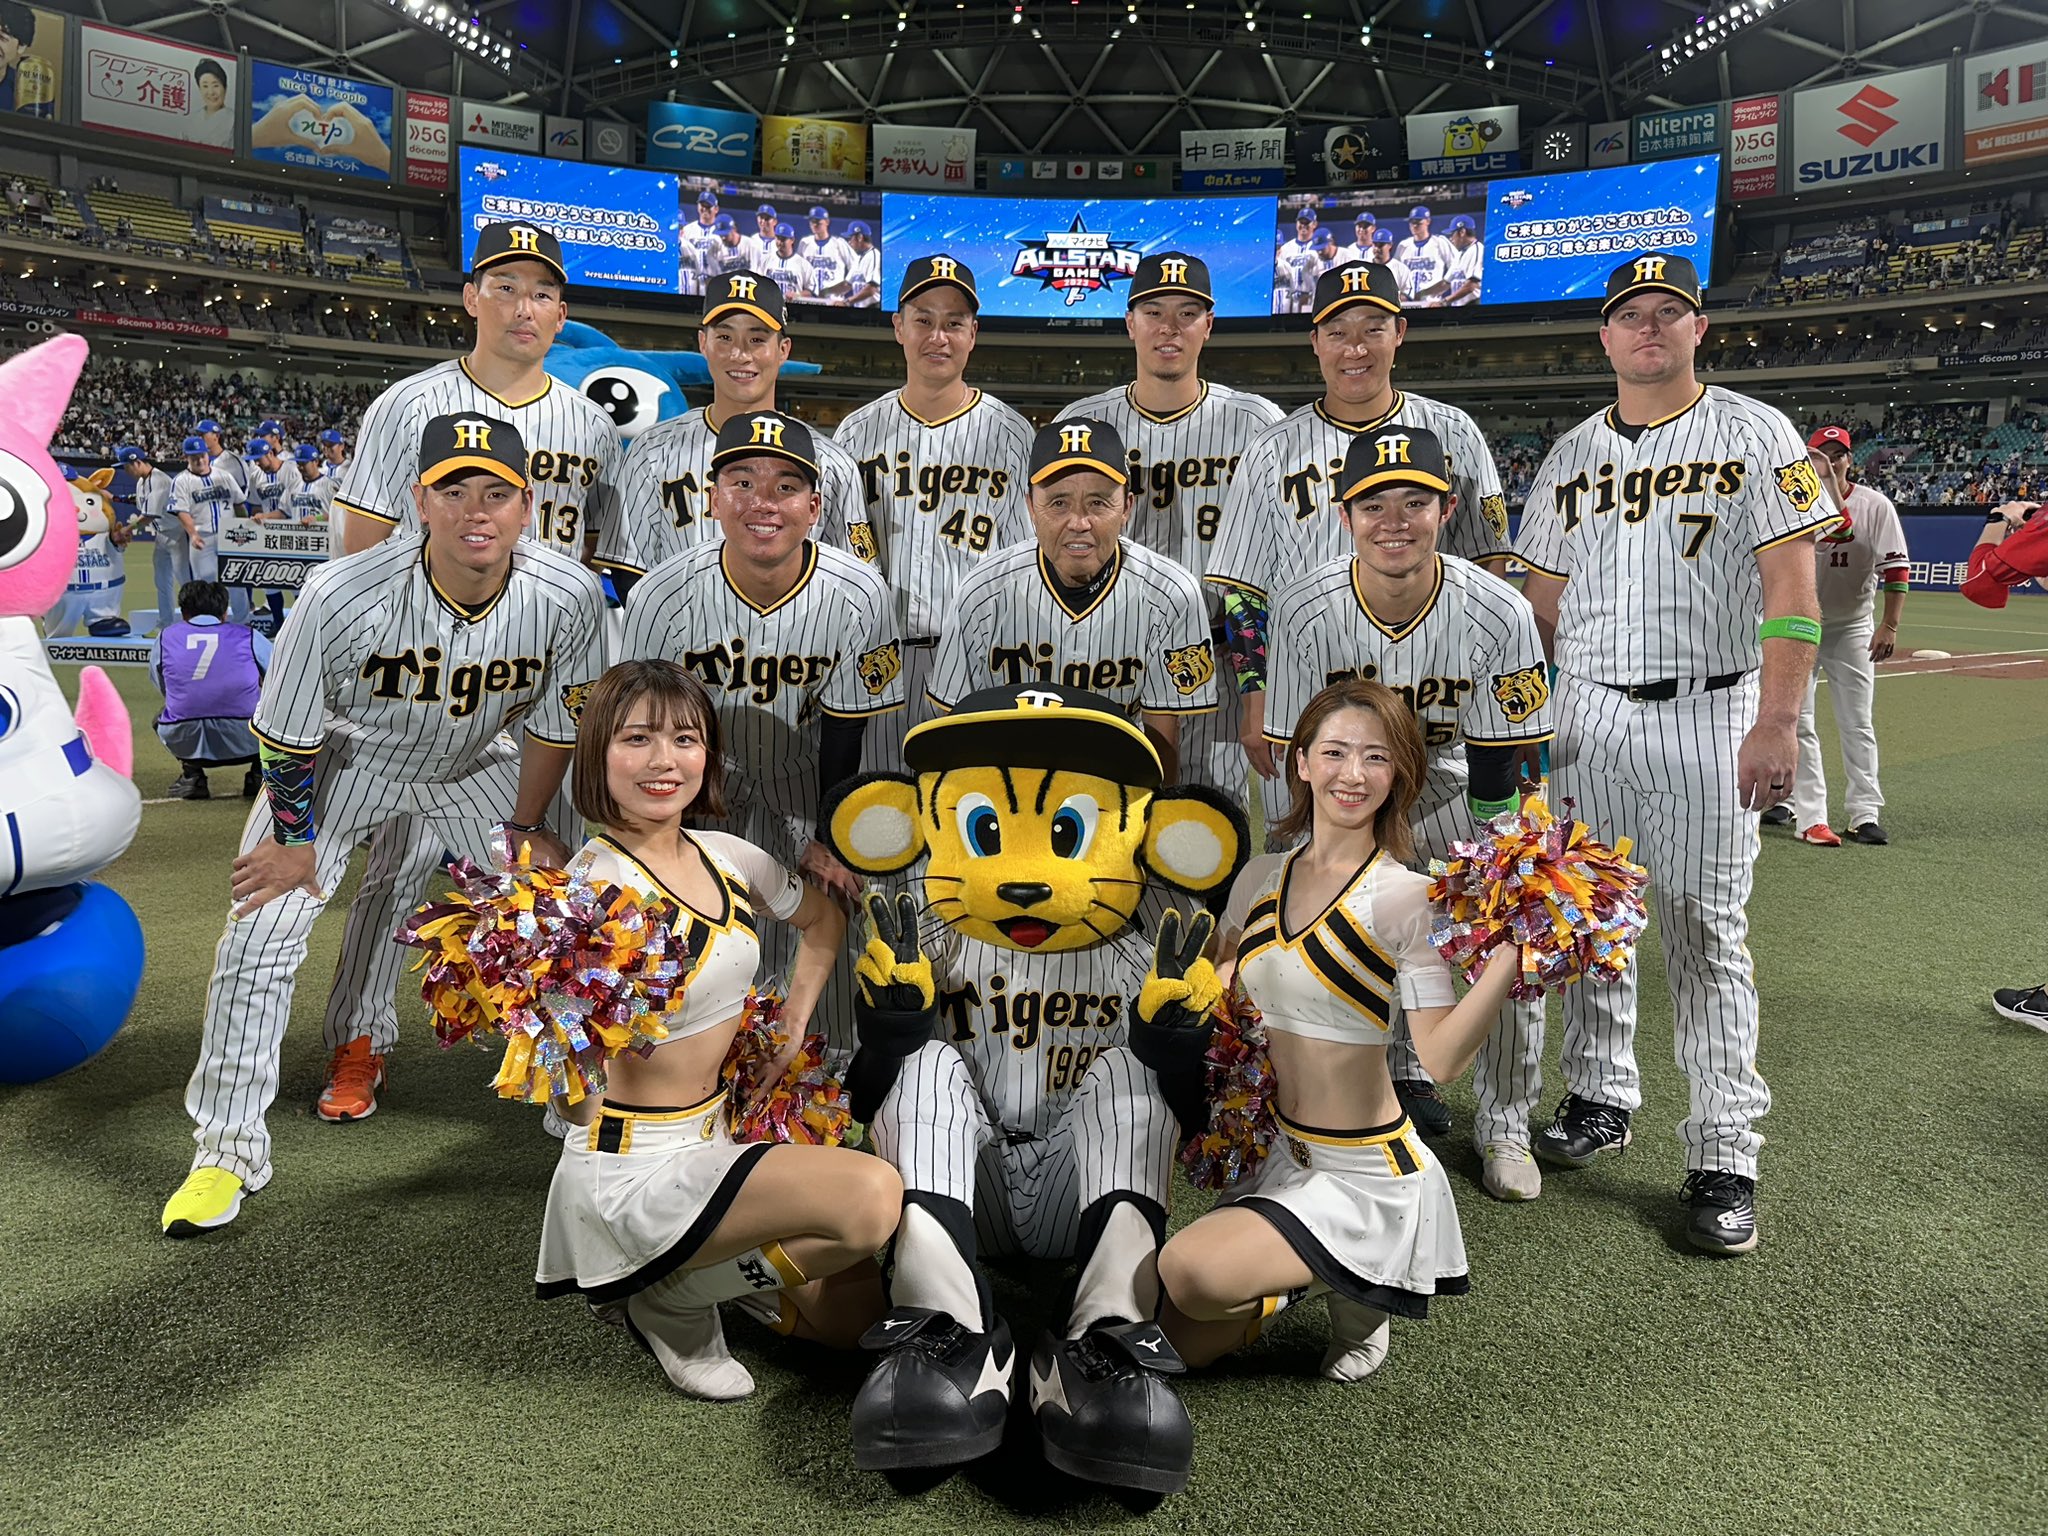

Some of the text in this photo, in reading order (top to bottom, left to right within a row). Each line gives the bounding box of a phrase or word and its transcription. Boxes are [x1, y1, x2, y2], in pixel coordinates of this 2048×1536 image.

[137, 80, 186, 111] 介護
[279, 78, 367, 104] Nice To People
[491, 121, 535, 134] MITSUBISHI
[491, 128, 529, 141] ELECTRIC
[1639, 112, 1715, 139] Niterra
[652, 125, 749, 157] CBC
[1184, 139, 1282, 162] 中日新聞
[1639, 130, 1715, 153] 日本特殊陶業
[284, 151, 359, 171] 名古屋トヨペット
[880, 157, 939, 177] 矢場とん
[1421, 155, 1506, 176] 東海テレビ
[1798, 142, 1939, 184] SUZUKI
[1204, 173, 1261, 187] 中日スポーツ
[1328, 170, 1369, 182] SAPPORO
[1507, 209, 1690, 238] ご来場ありがとうございました。
[1071, 237, 1104, 247] マイナビ
[1053, 268, 1100, 278] GAME
[1063, 279, 1089, 287] 2023
[858, 450, 1008, 513] Tigers
[1555, 460, 1746, 534] Tigers
[539, 499, 580, 545] 13
[941, 508, 995, 553] 49
[1197, 504, 1222, 543] 8
[1676, 512, 1719, 560] 7
[1830, 552, 1848, 567] 11
[49, 647, 85, 660] マイナビ
[186, 633, 219, 680] 7
[940, 974, 1122, 1051] Tigers
